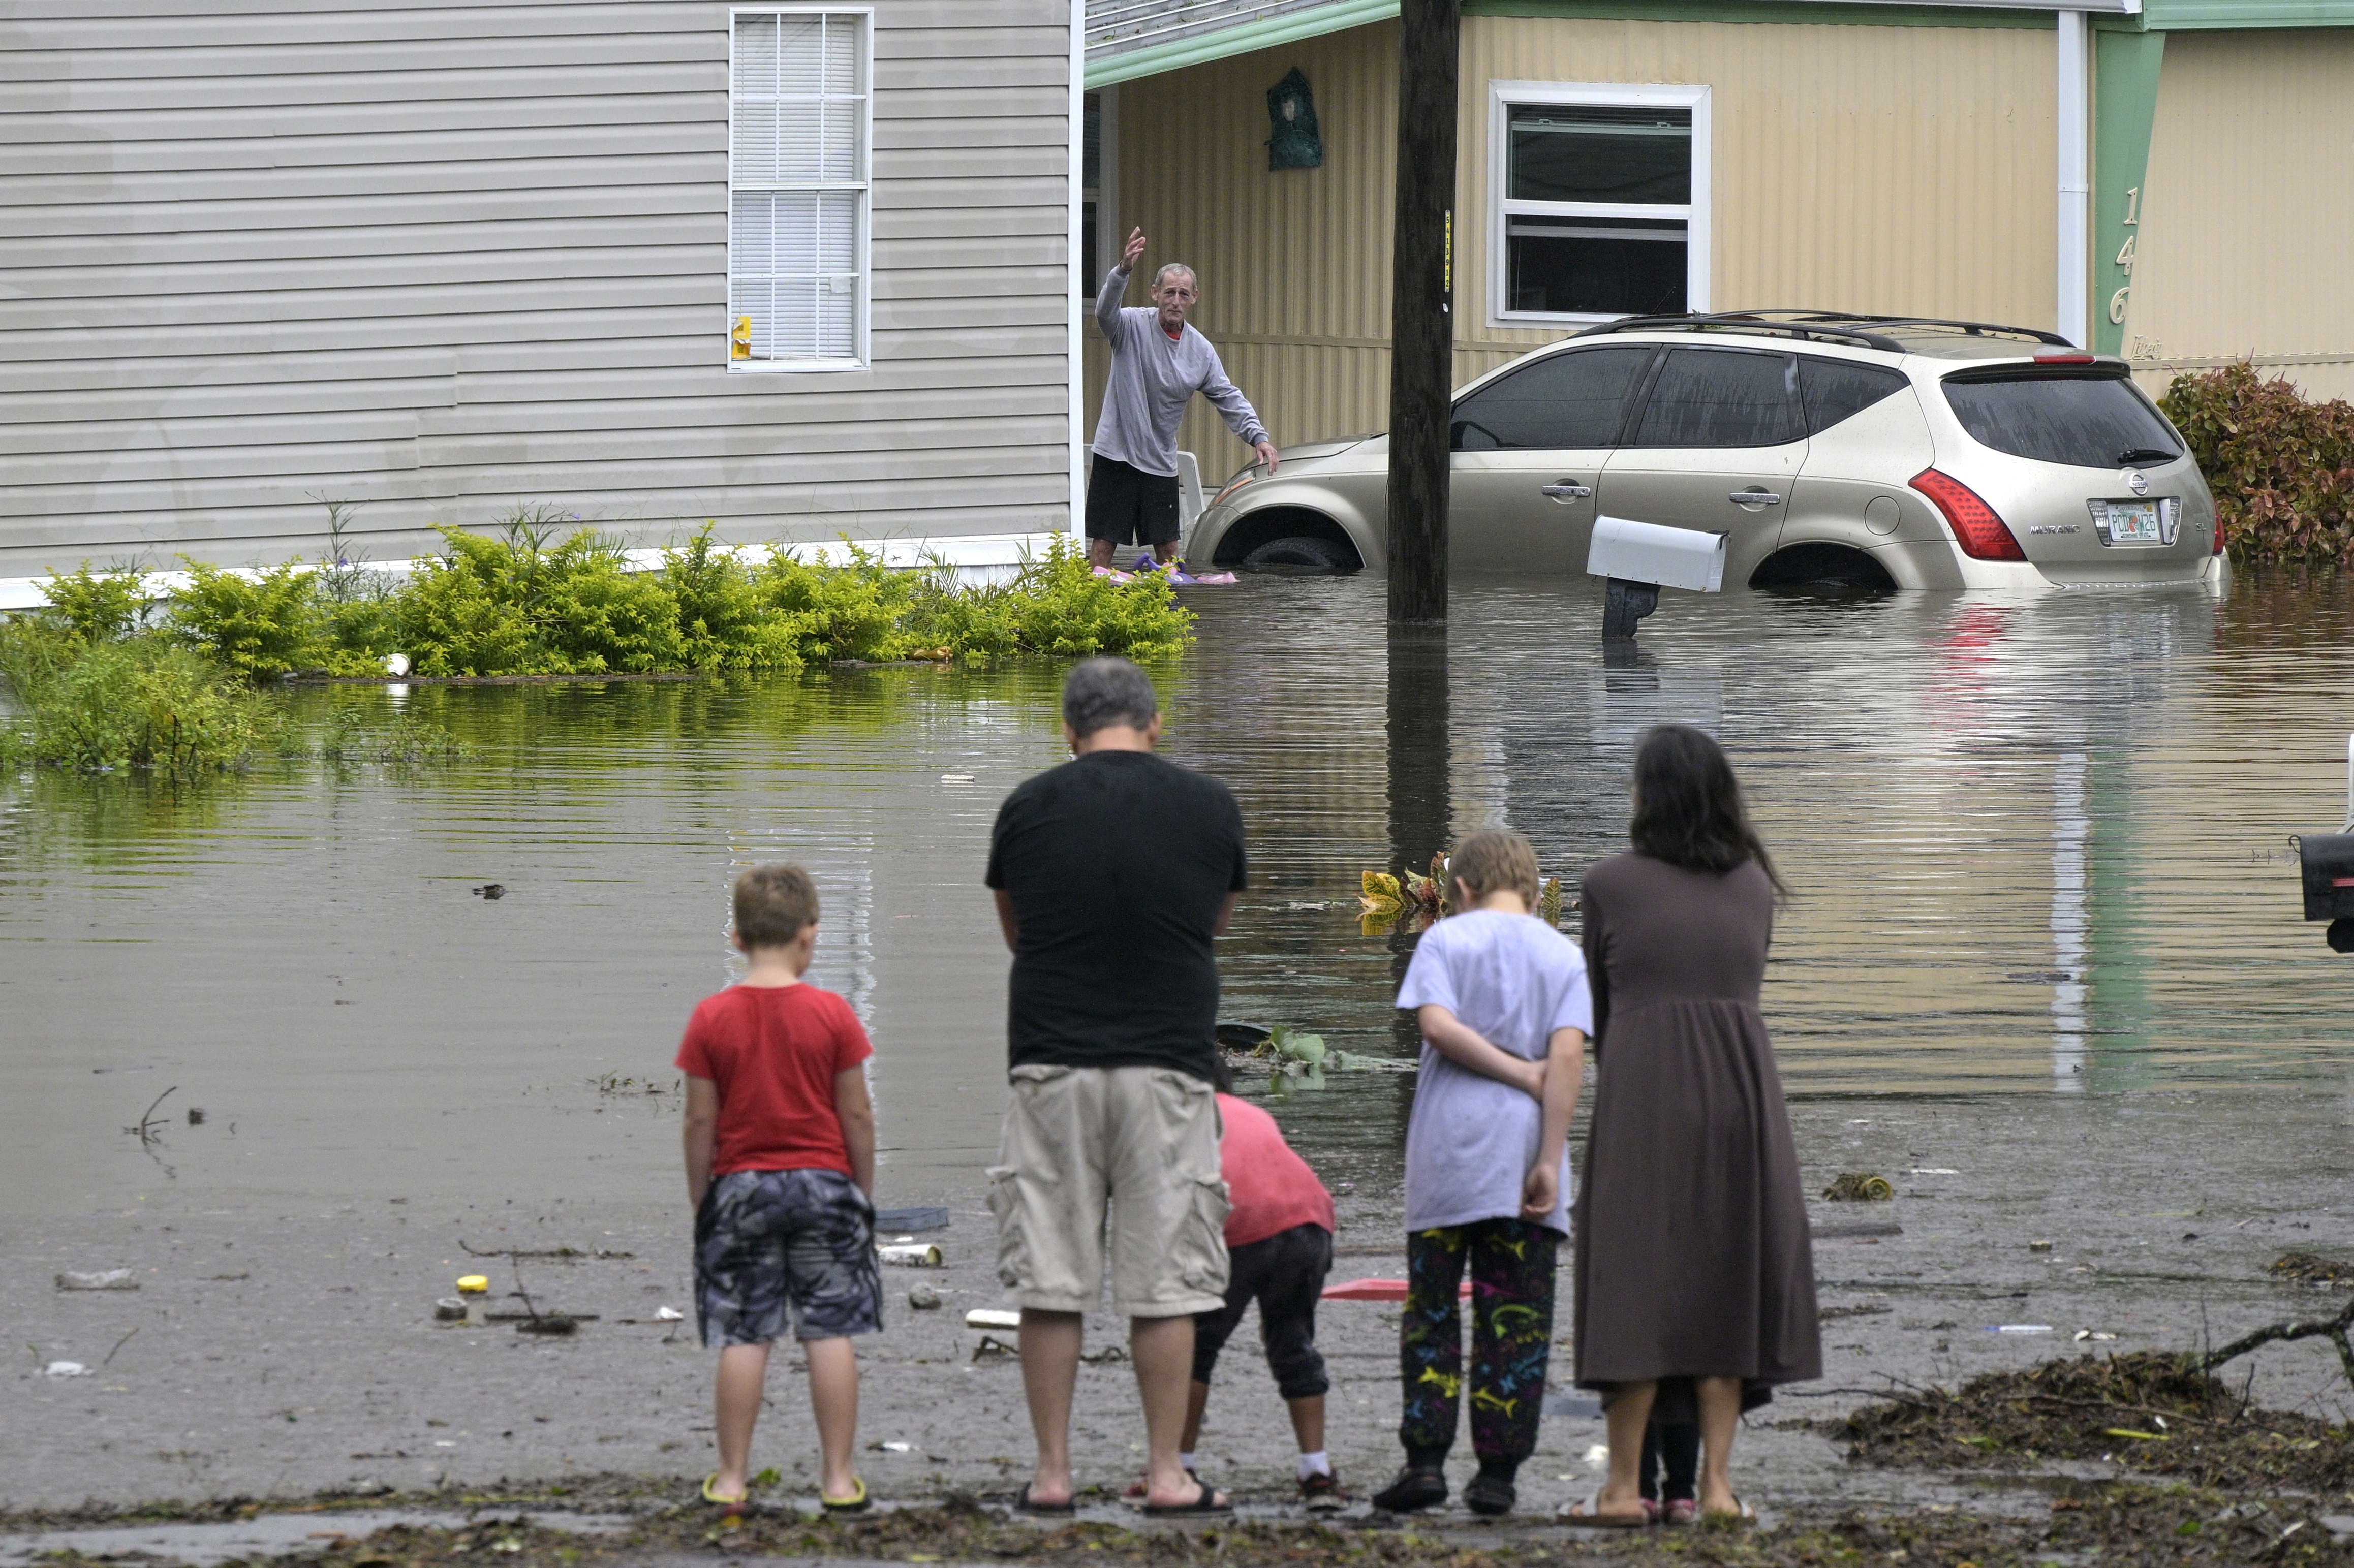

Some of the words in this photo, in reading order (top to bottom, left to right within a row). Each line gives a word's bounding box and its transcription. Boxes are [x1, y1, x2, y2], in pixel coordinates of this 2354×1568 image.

[2109, 187, 2138, 325] 146
[2030, 524, 2080, 535] MURANO
[2196, 522, 2207, 531] SL
